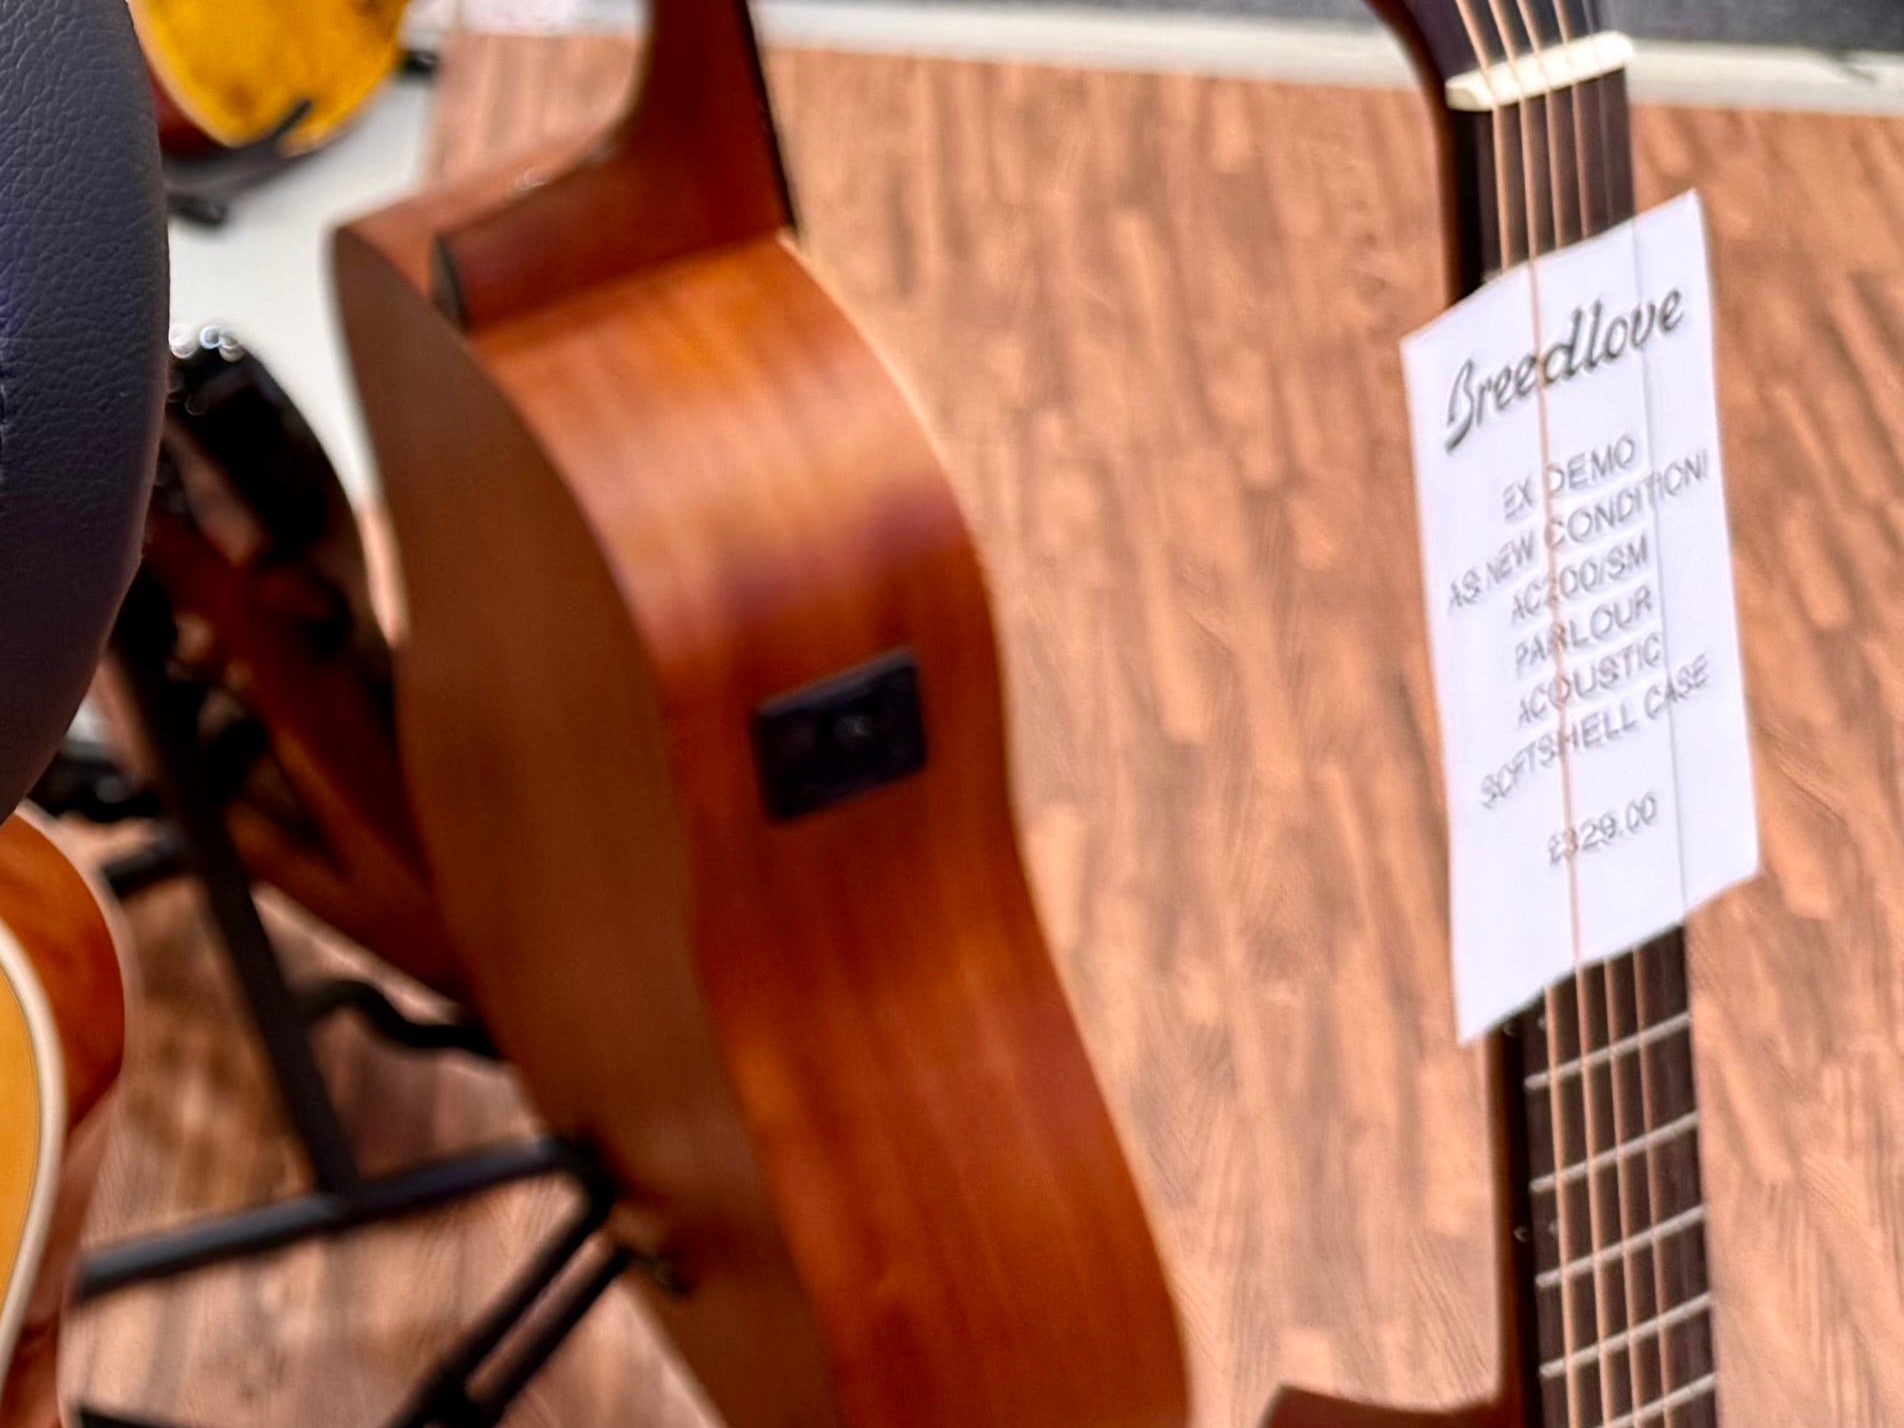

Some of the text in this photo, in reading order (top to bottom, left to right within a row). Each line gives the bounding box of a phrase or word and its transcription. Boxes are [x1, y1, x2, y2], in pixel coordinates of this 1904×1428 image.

[1445, 288, 1684, 455] Breedlove
[1503, 434, 1635, 523] EX DEMO
[1486, 529, 1534, 591] NEW
[1515, 584, 1653, 675] PARLOUR
[1518, 632, 1663, 724] ACOUSTIC
[1480, 651, 1709, 810] SOFTSHELL CASE
